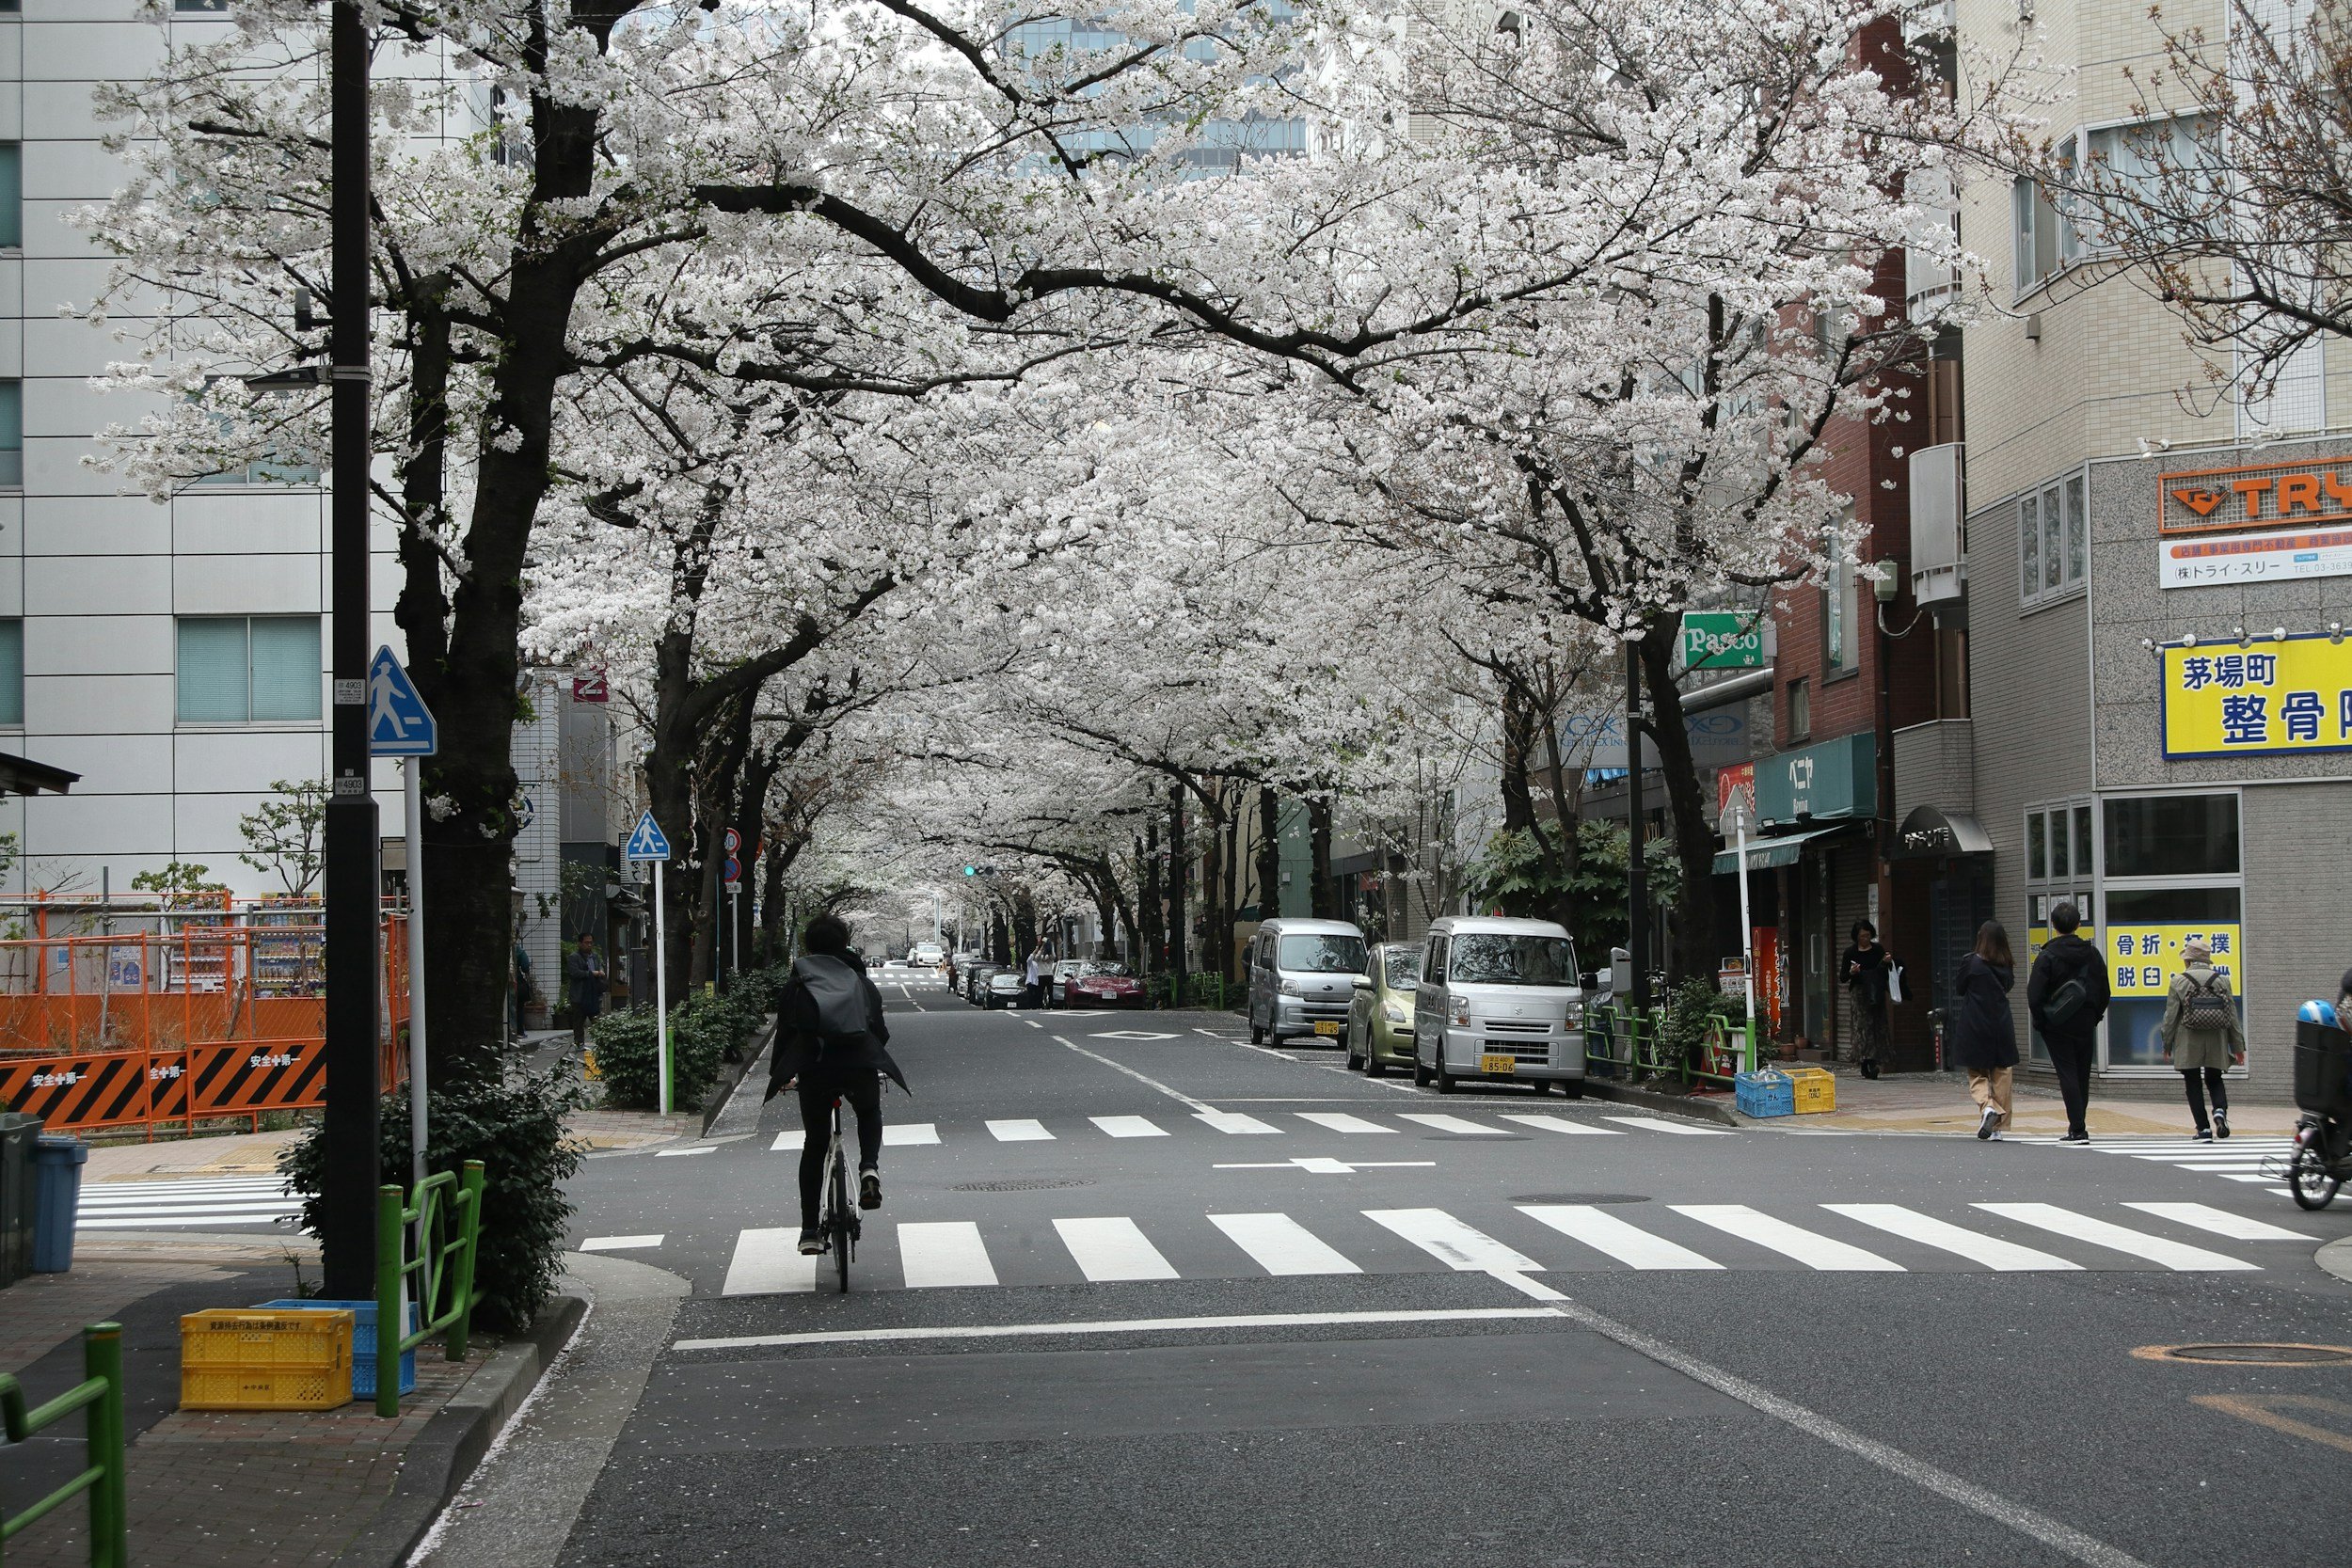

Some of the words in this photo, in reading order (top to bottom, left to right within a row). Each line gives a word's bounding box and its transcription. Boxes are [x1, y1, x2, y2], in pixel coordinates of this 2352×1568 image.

[2183, 655, 2277, 689] 茅場町
[1488, 1062, 1513, 1072] 85-06
